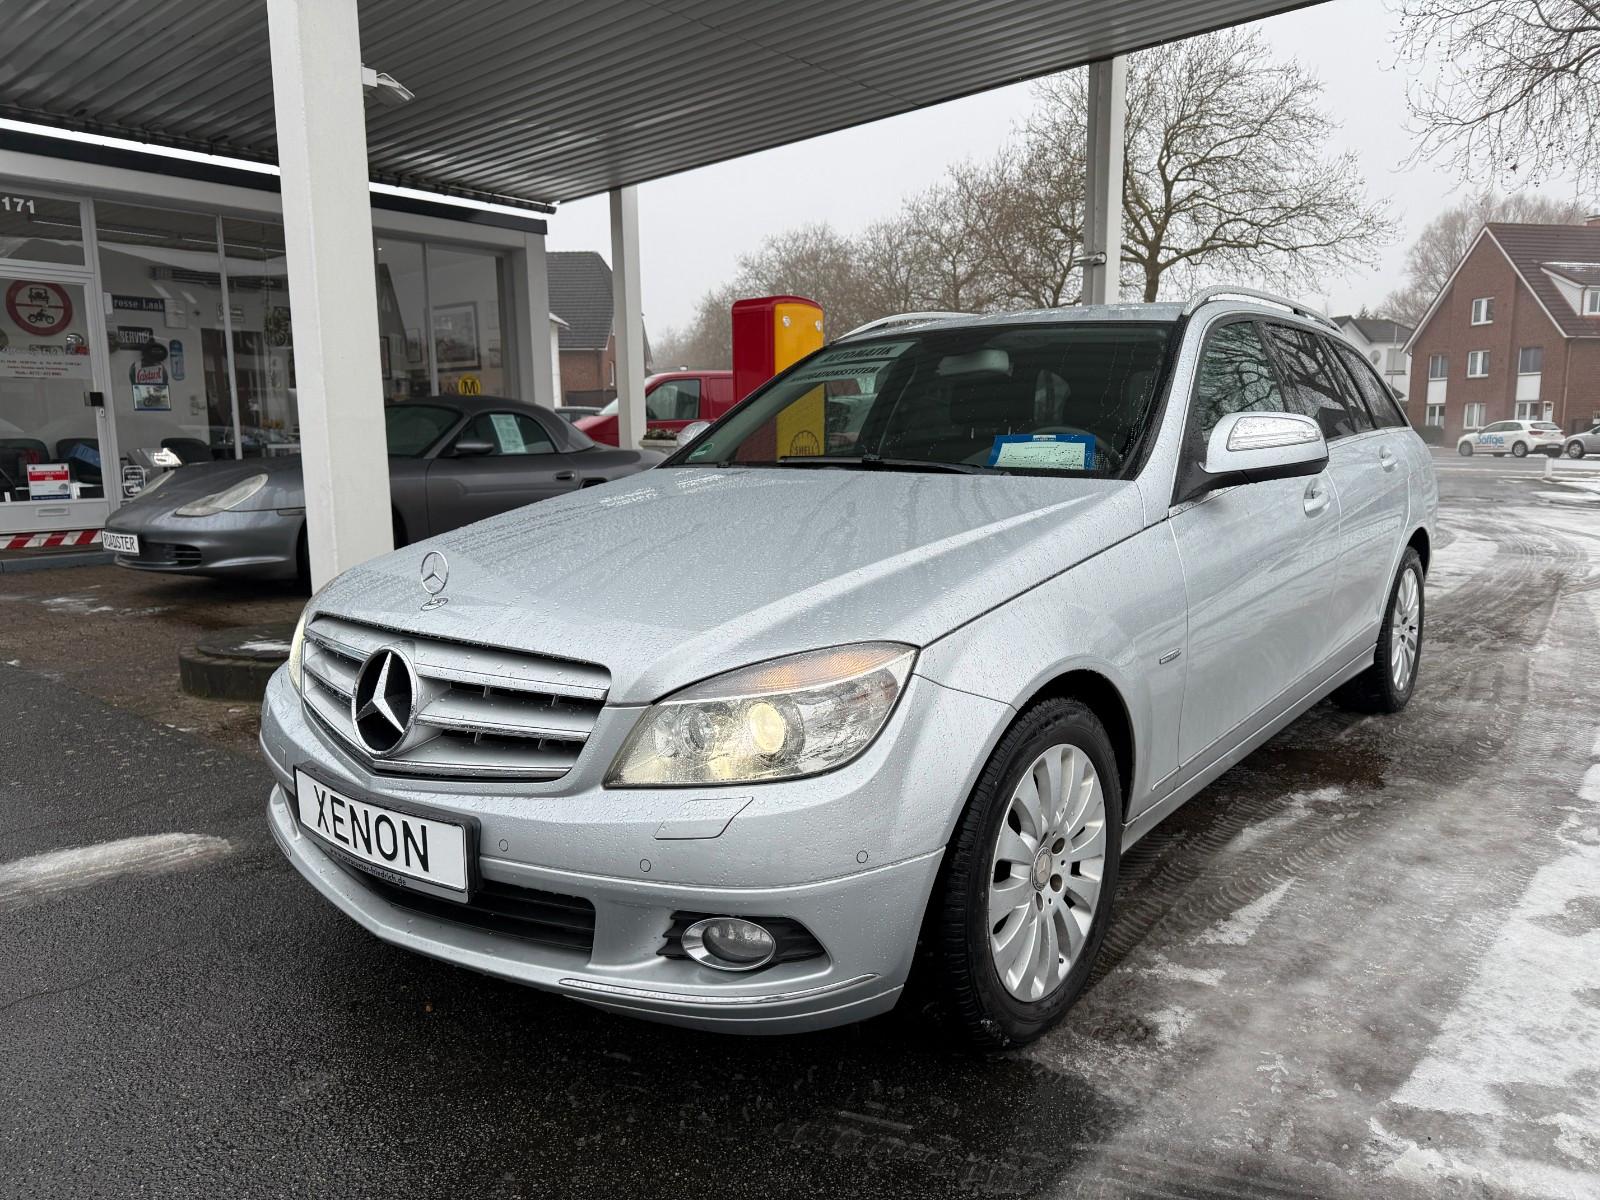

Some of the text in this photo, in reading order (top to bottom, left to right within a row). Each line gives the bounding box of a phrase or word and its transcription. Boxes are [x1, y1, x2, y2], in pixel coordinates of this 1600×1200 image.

[1, 196, 35, 214] 171
[825, 345, 896, 361] AUTOMATIK
[793, 446, 816, 456] SHELL
[103, 533, 136, 551] ROADSTER
[313, 784, 430, 873] XENON
